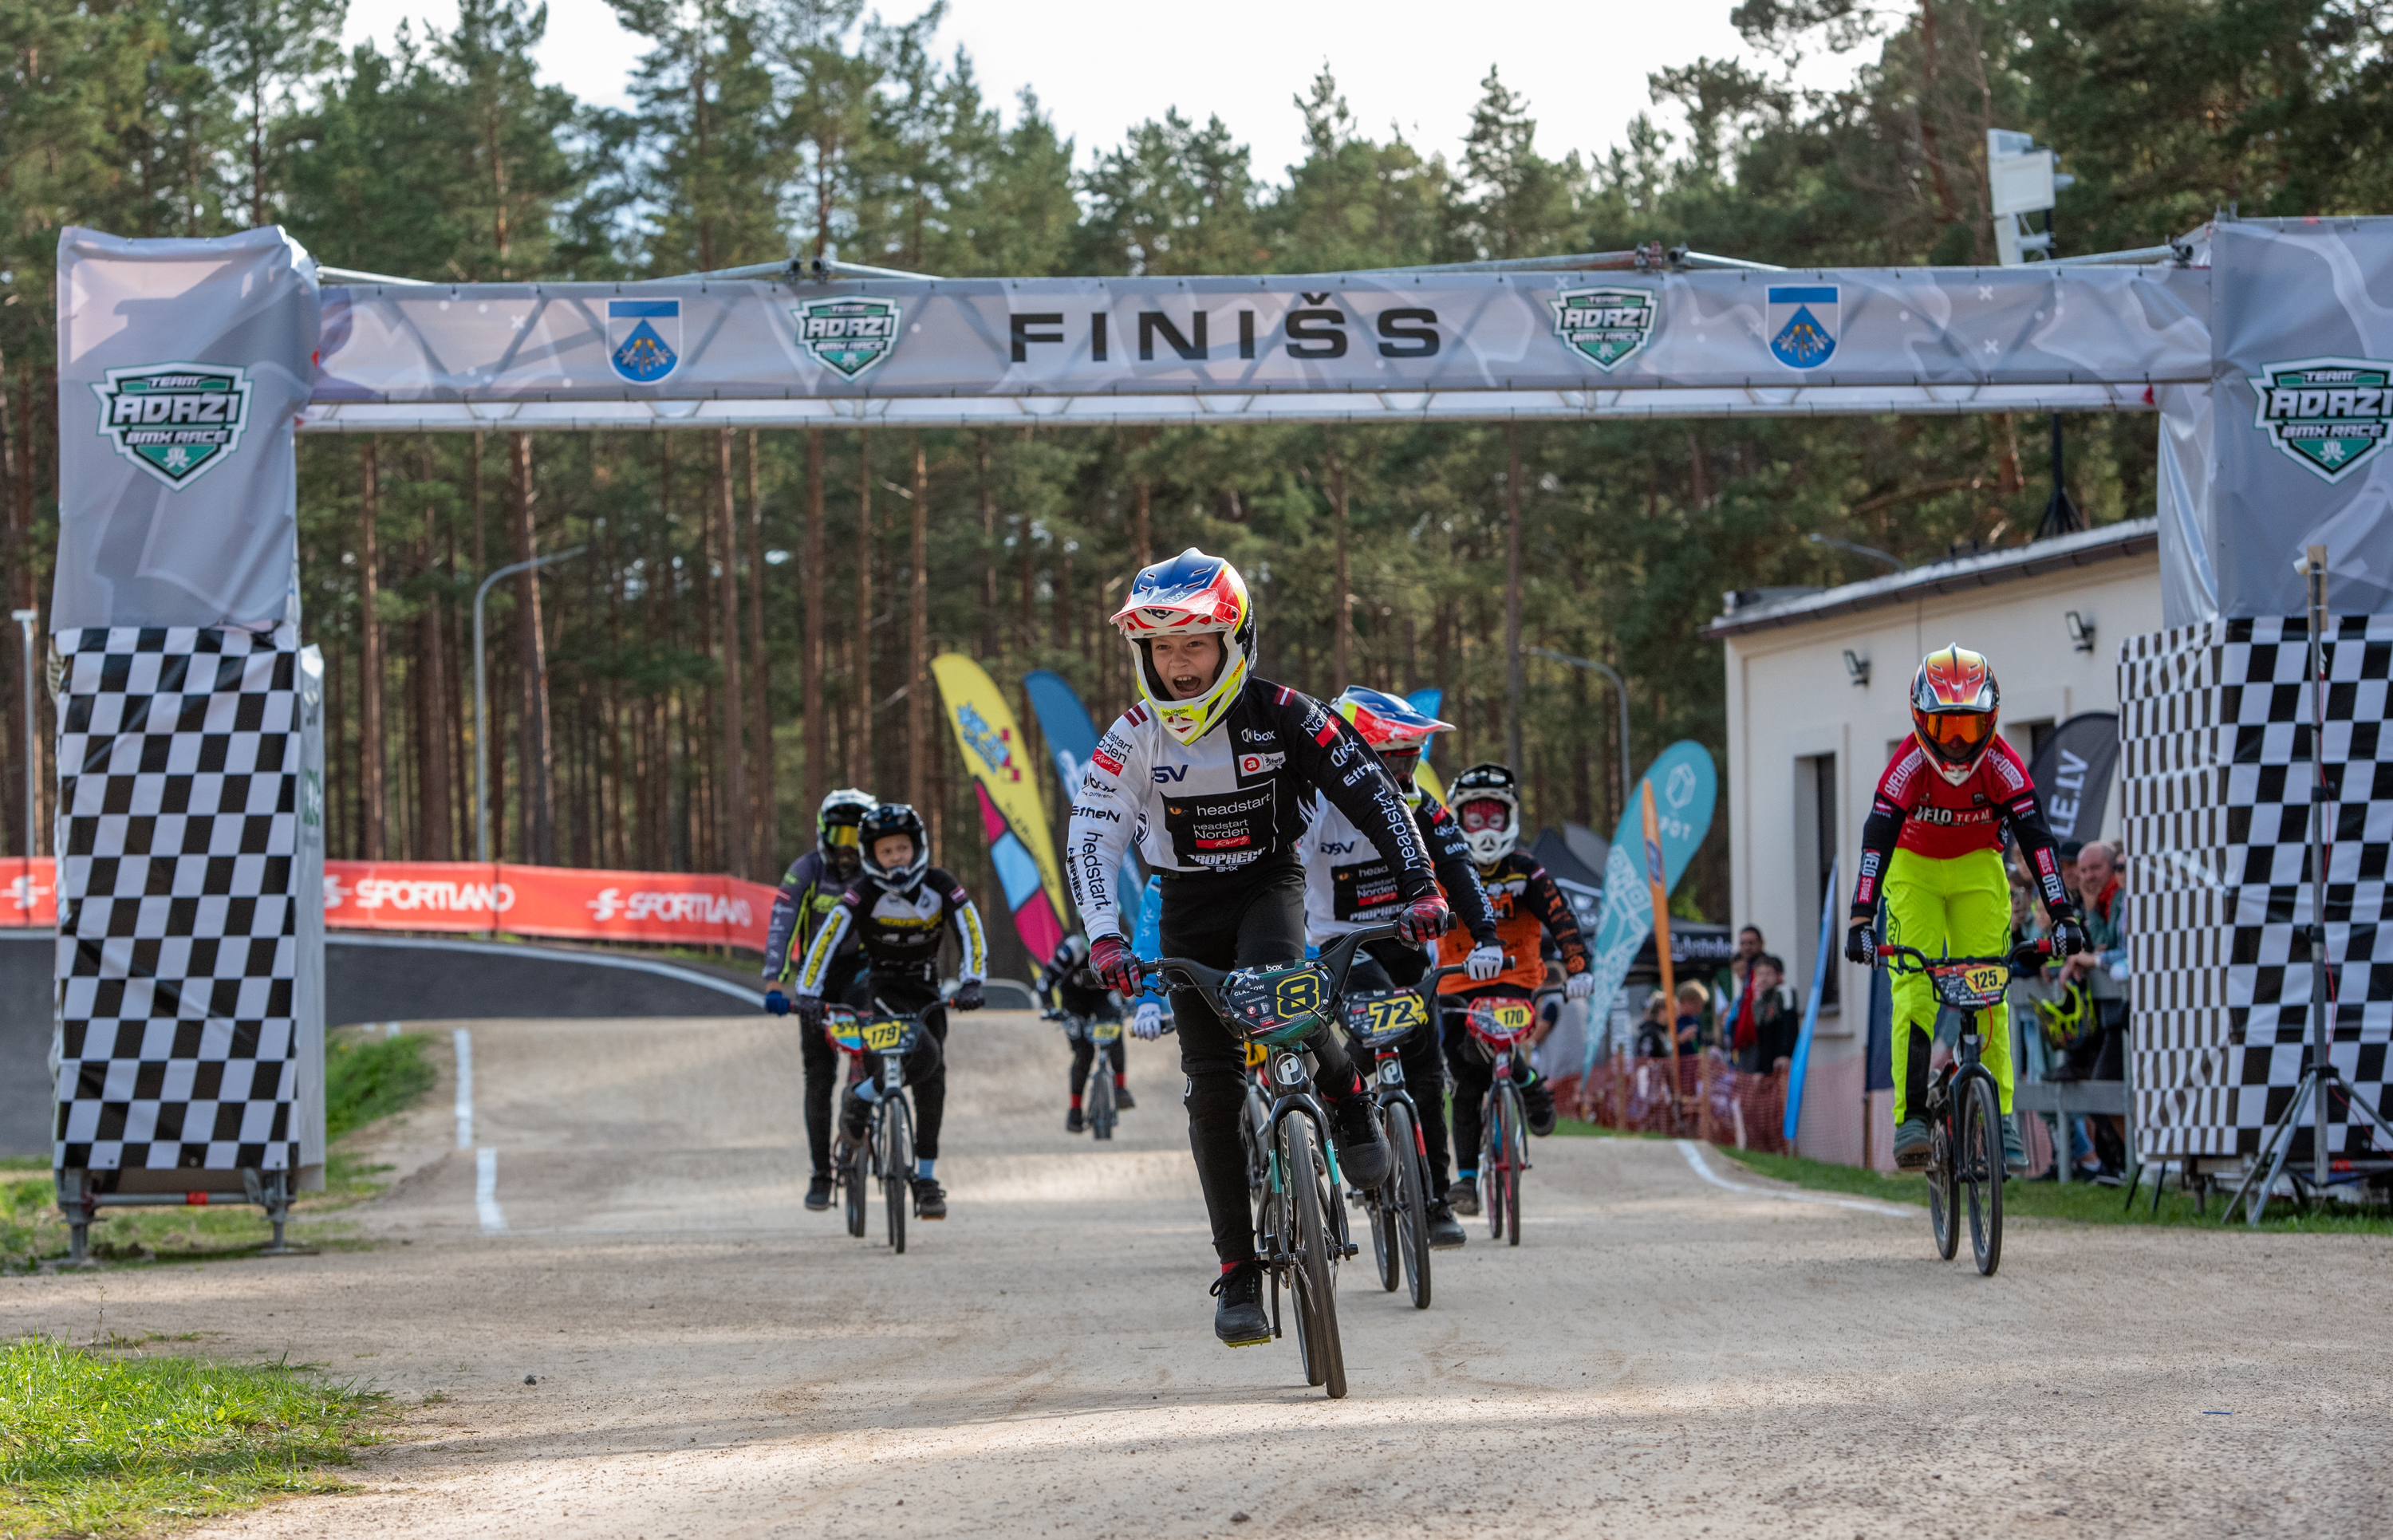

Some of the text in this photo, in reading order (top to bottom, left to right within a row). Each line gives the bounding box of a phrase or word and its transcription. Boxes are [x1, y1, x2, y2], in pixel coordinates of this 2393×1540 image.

[1009, 292, 1441, 362] FINIŠS
[149, 376, 199, 388] TEAM
[2306, 371, 2353, 382] TEAM
[125, 429, 229, 444] BMX RACE
[2281, 424, 2383, 438] BMX RACE
[1253, 730, 1276, 742] box
[1196, 793, 1271, 817] headstart
[1072, 805, 1121, 823] EtheN
[1956, 809, 1990, 823] TEAM
[1193, 818, 1249, 830] headstart
[1194, 826, 1250, 840] Norden
[355, 878, 516, 912] SPORTLAND
[1265, 963, 1283, 972] box
[1973, 969, 1998, 990] 125
[1277, 974, 1319, 1019] 8
[1372, 1000, 1416, 1029] 72
[1504, 1009, 1524, 1025] 170
[872, 1026, 897, 1045] 179
